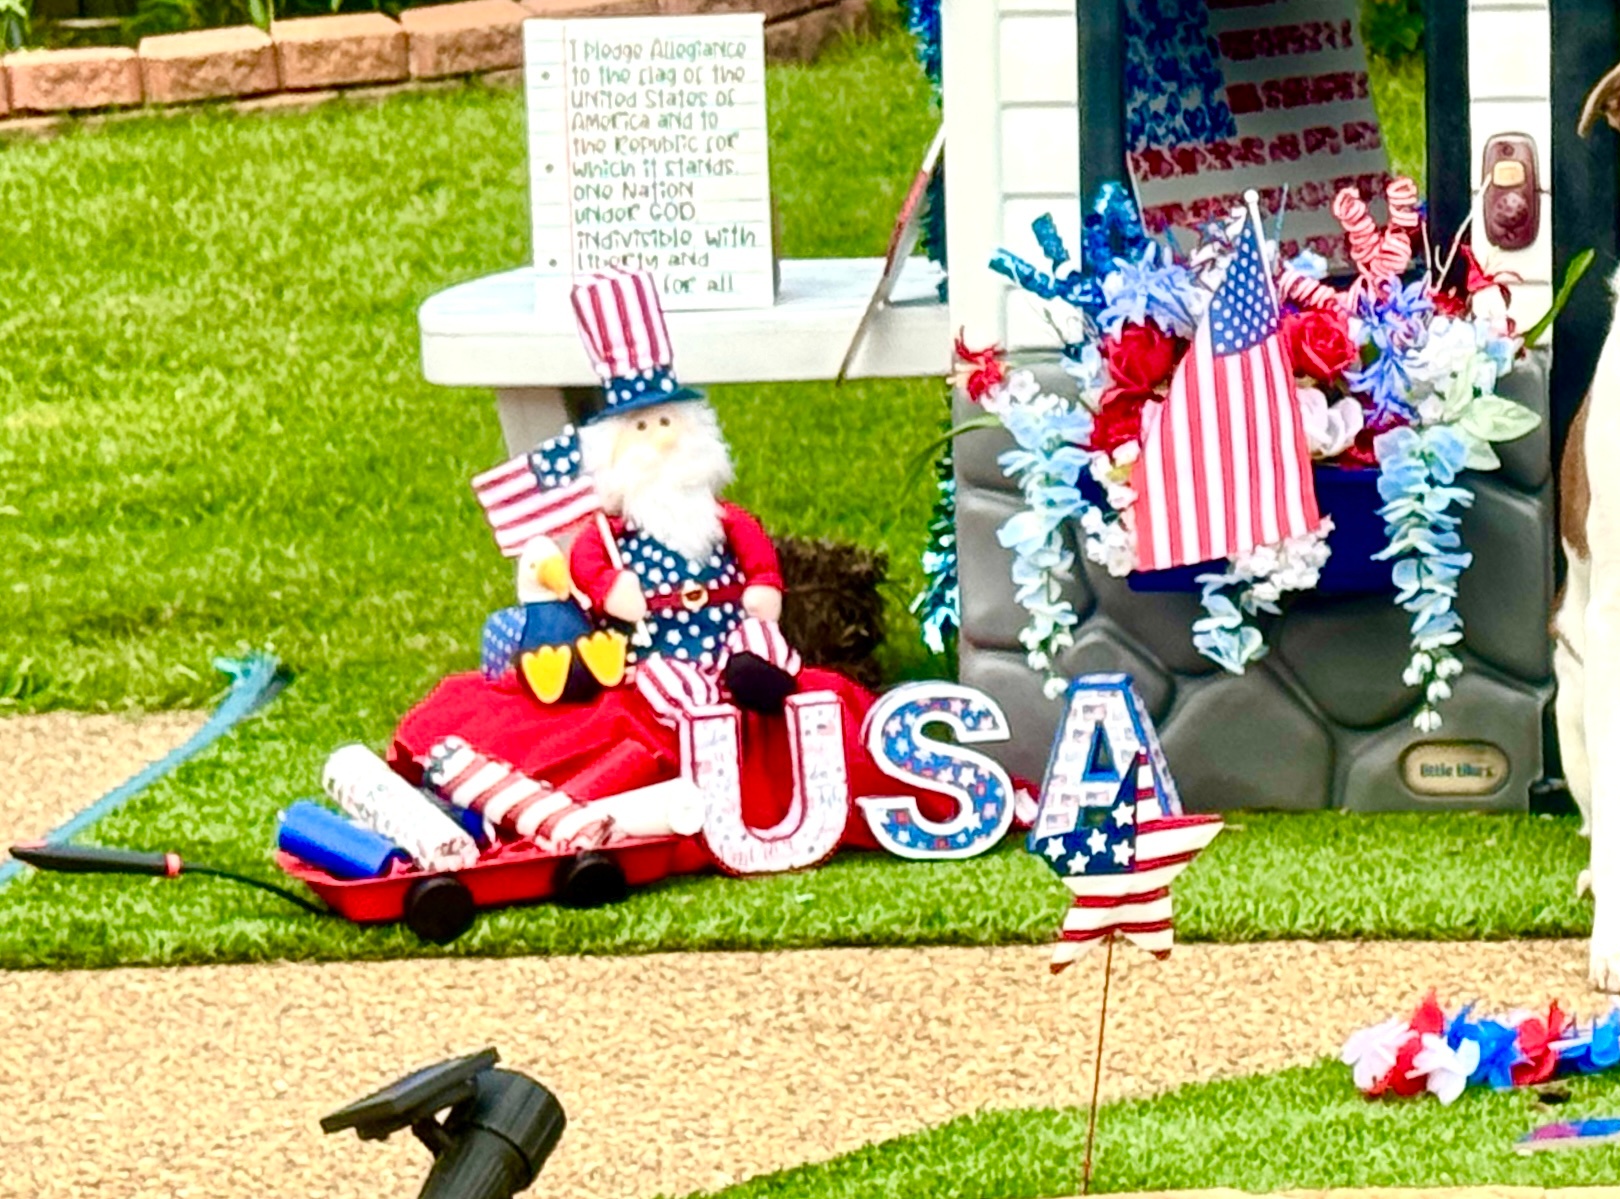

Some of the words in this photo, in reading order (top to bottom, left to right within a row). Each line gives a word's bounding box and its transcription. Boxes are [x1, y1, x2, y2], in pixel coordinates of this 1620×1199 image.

[569, 39, 577, 63] I
[572, 65, 590, 87] to
[599, 65, 631, 87] the
[638, 65, 677, 88] flag
[683, 66, 704, 86] of
[711, 63, 745, 85] the
[645, 88, 708, 109] States
[715, 87, 736, 107] of
[571, 111, 650, 132] America
[700, 109, 719, 131] to
[573, 136, 607, 157] the
[705, 131, 739, 154] for
[573, 159, 636, 179] which
[643, 157, 656, 179] it
[574, 204, 640, 225] under
[705, 222, 756, 248] with
[663, 272, 696, 295] for
[706, 271, 733, 293] all
[682, 672, 1184, 876] USA
